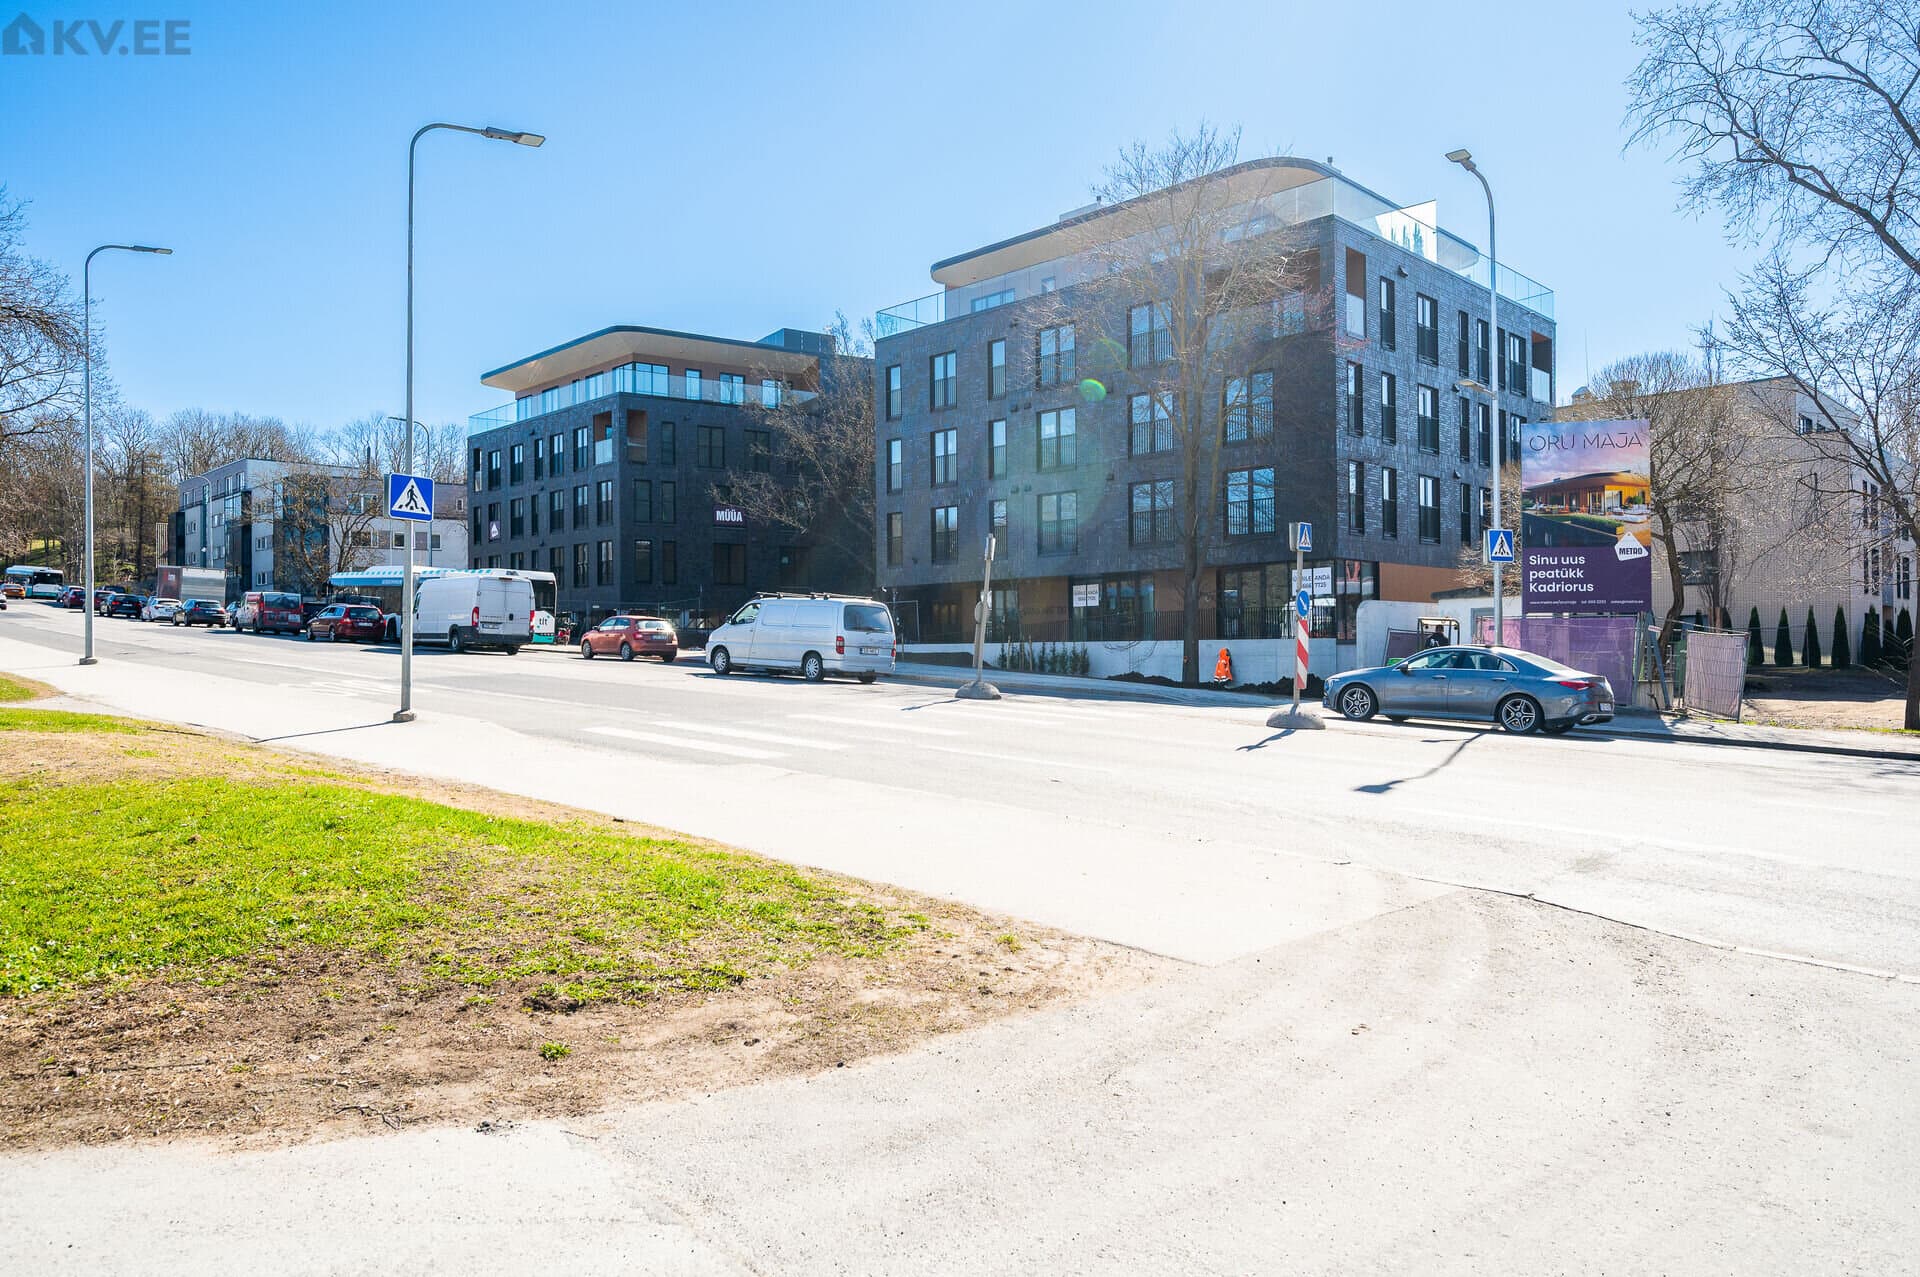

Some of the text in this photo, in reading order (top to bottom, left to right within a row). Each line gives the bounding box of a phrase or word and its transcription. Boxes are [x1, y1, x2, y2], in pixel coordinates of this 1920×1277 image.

[1529, 432, 1643, 451] ORU MAJA
[716, 508, 743, 522] MÜÜA
[1619, 547, 1643, 555] METRO
[1529, 554, 1586, 565] Sinu uus
[1529, 568, 1584, 582] peatükk
[1529, 582, 1594, 592] Kadriorus
